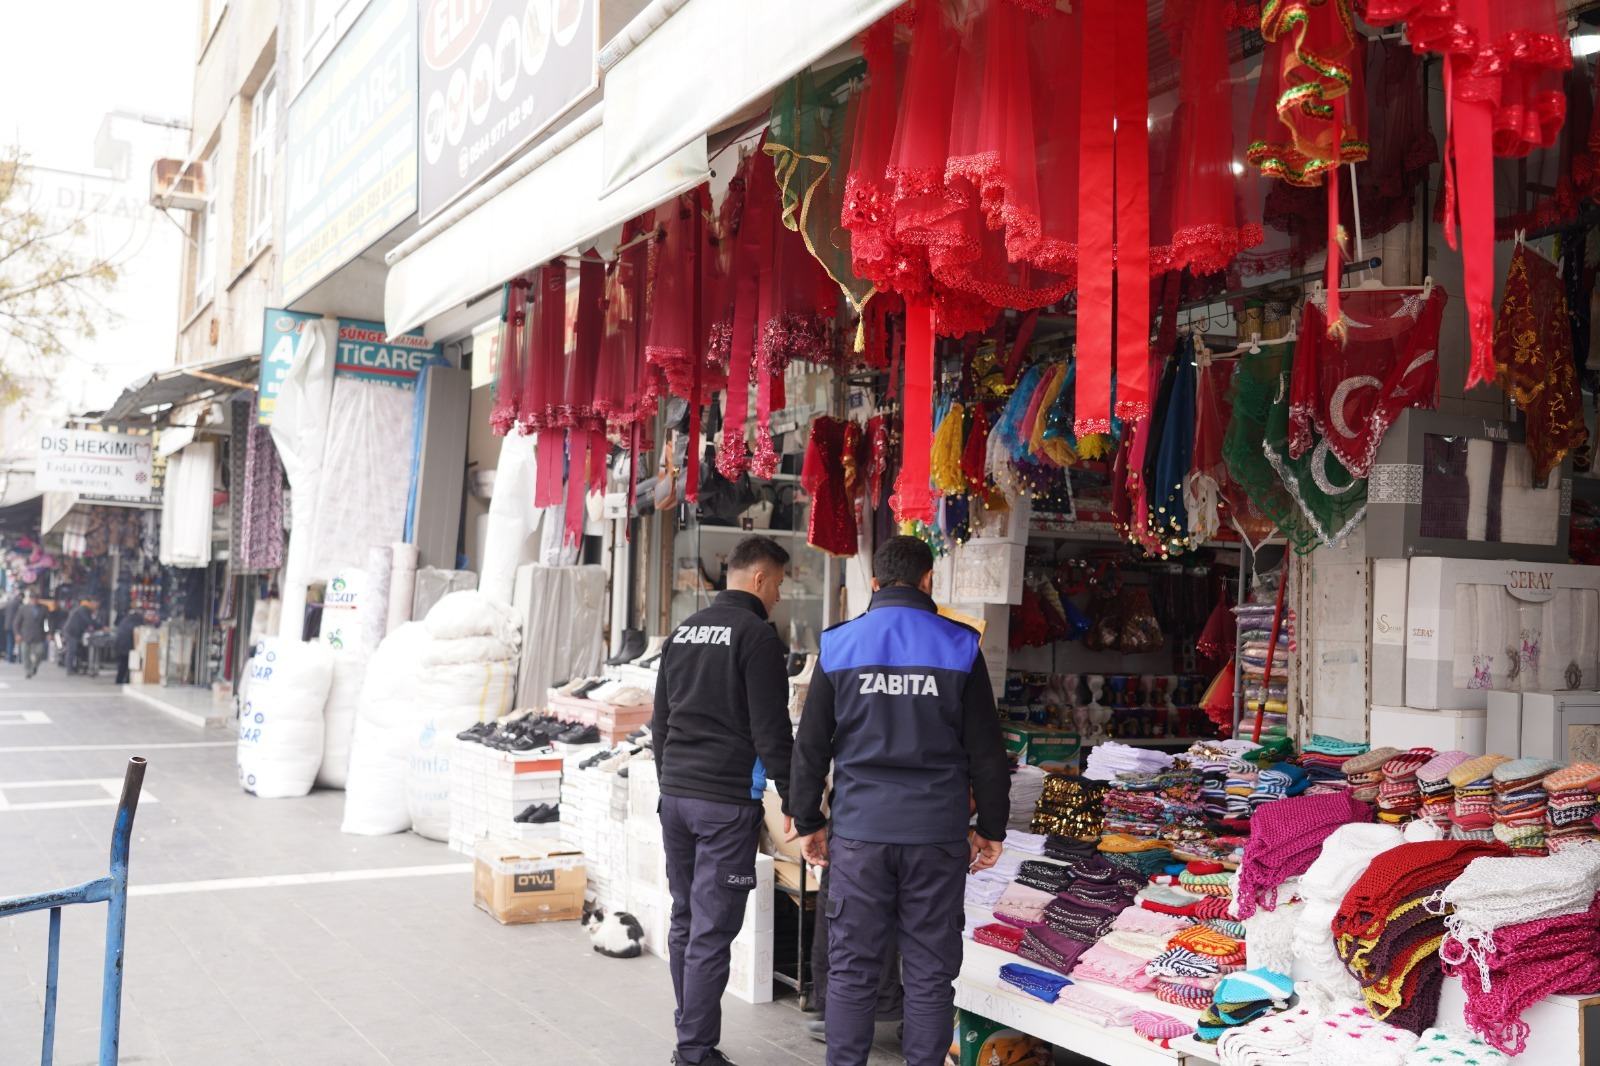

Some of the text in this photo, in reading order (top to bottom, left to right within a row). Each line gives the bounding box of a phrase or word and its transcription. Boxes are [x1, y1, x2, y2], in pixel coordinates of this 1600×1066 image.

[490, 117, 507, 146] 977
[508, 106, 521, 131] 82
[521, 94, 534, 120] 90
[1510, 570, 1554, 590] SERAY
[672, 625, 731, 647] ZABITA
[1412, 628, 1435, 638] SERAY
[858, 673, 938, 697] ZABITA
[518, 874, 553, 886] TALO
[727, 874, 754, 885] ZABITA
